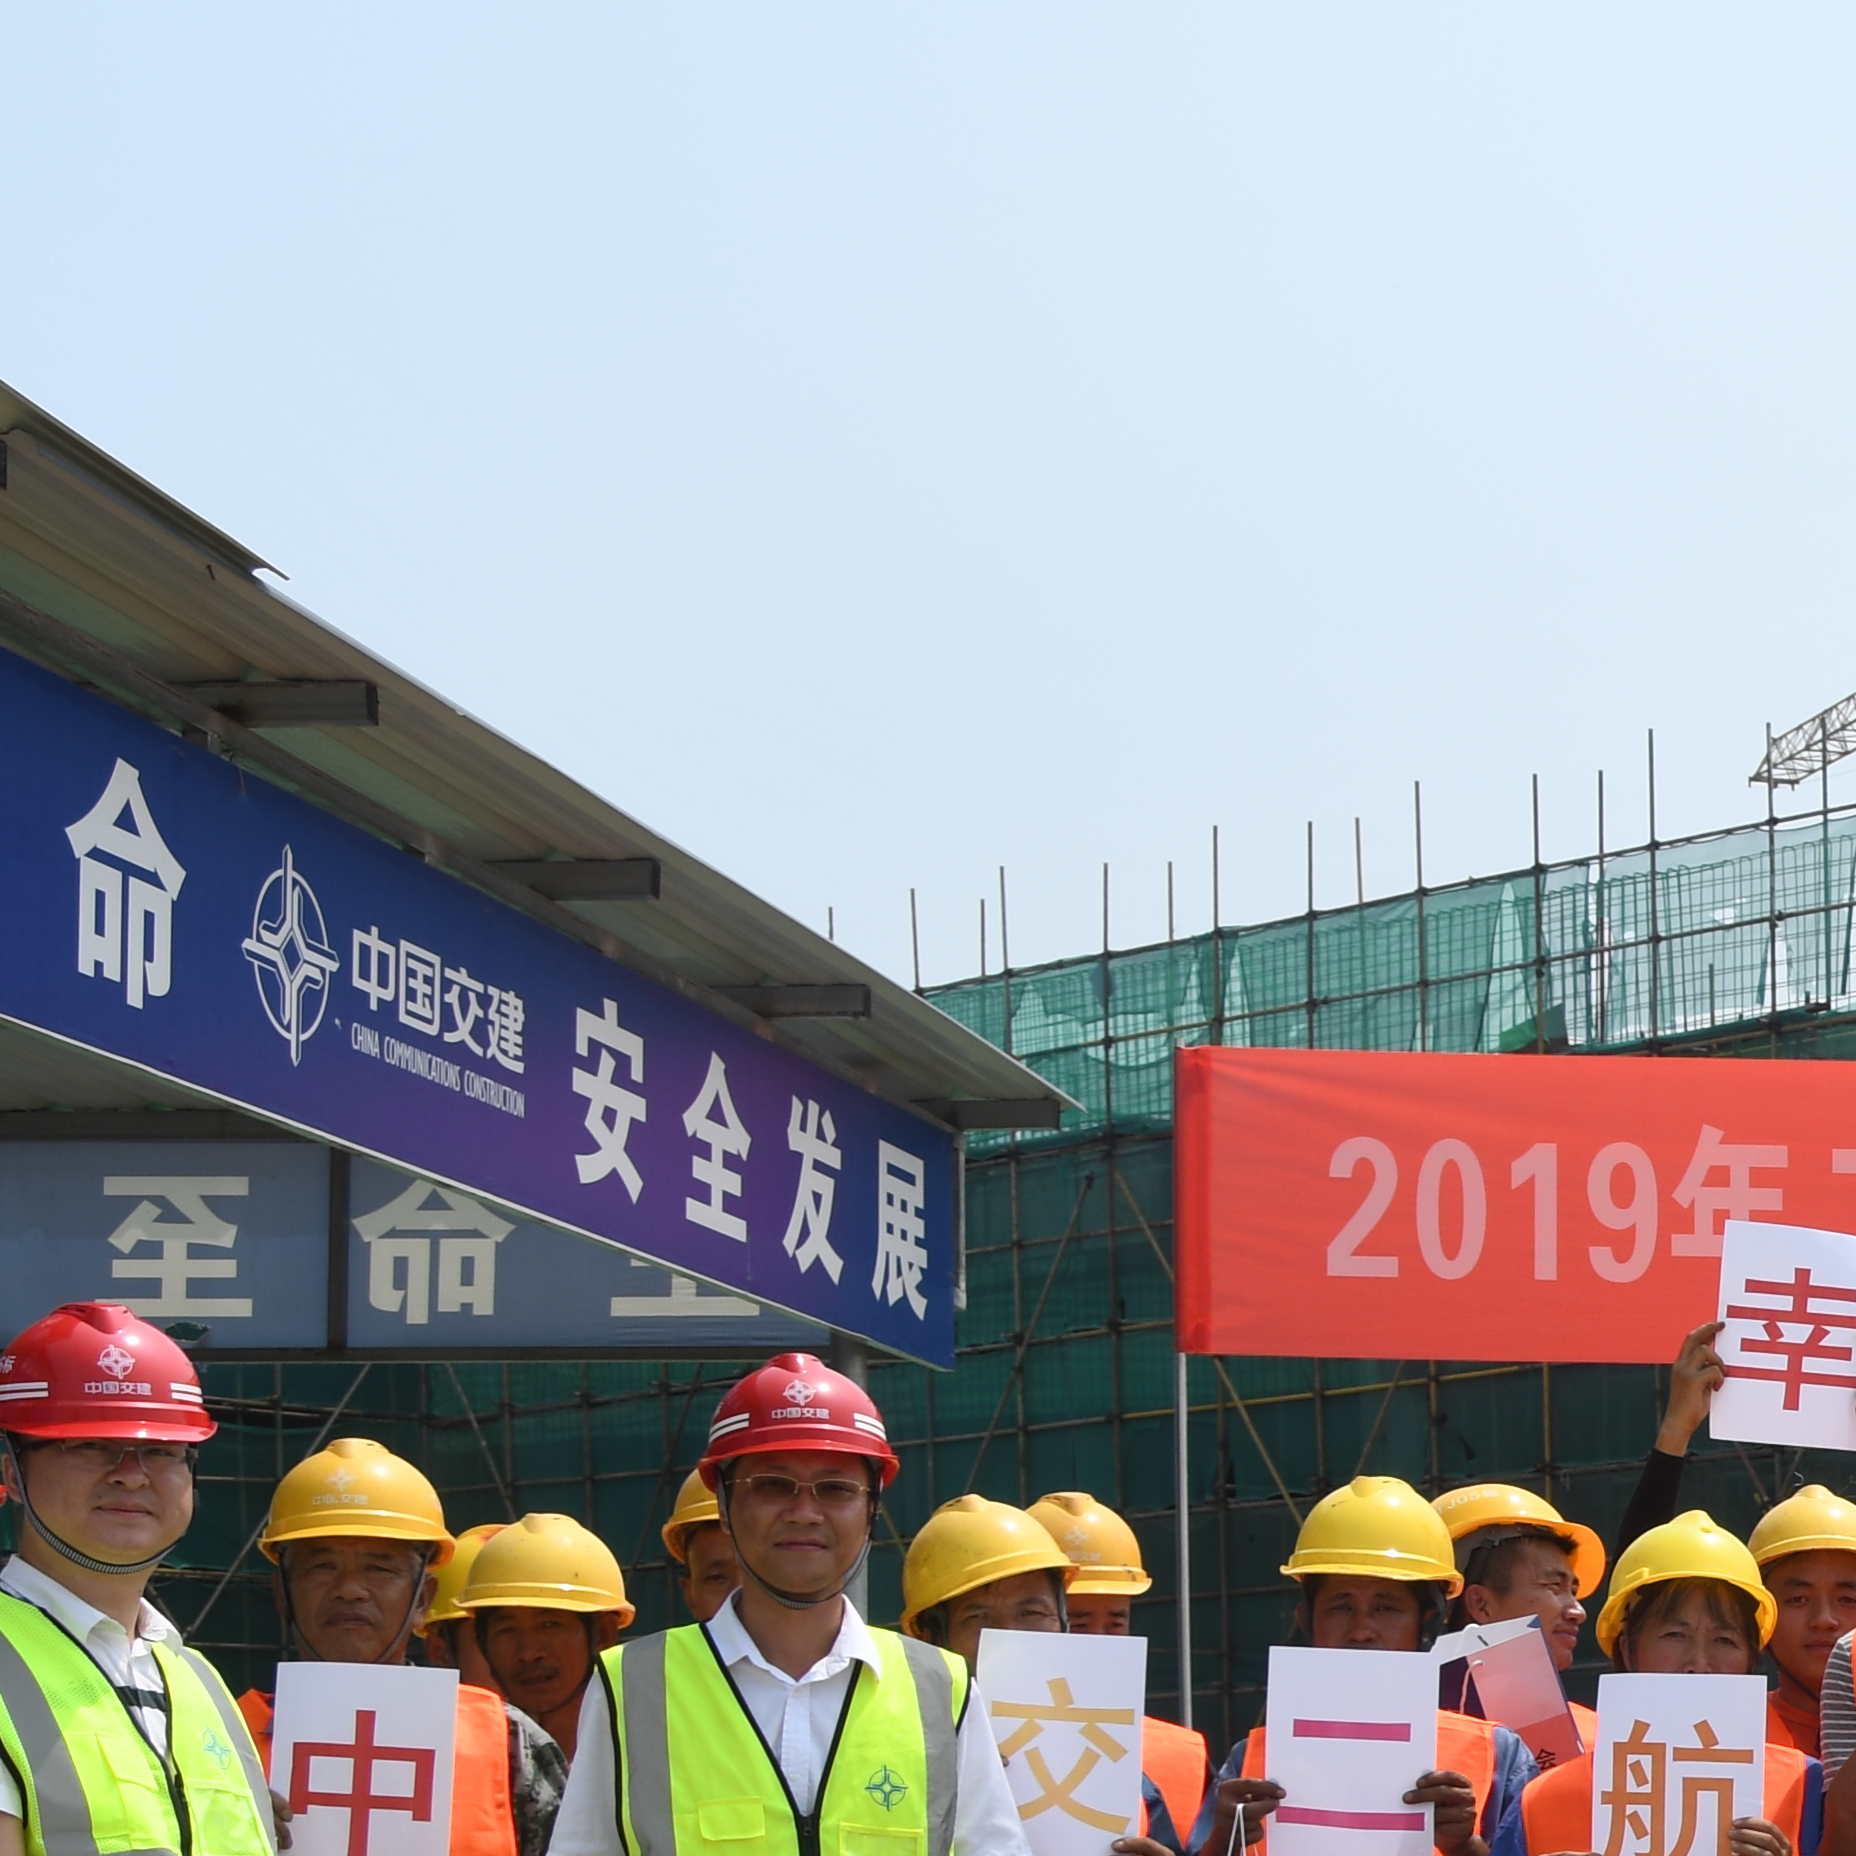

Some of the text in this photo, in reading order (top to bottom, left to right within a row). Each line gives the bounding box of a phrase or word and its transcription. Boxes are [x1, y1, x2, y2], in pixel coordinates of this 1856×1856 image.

[65, 757, 186, 1009] 命
[352, 925, 525, 1074] 中国交建
[351, 1022, 524, 1118] CHINA COMMUNICATIONS CONSTRUCTION
[572, 997, 928, 1321] 安全发展
[84, 1381, 152, 1396] 中国交建
[770, 1407, 831, 1420] 中国交建
[991, 1677, 1135, 1834] 交
[1275, 1717, 1425, 1832] 二
